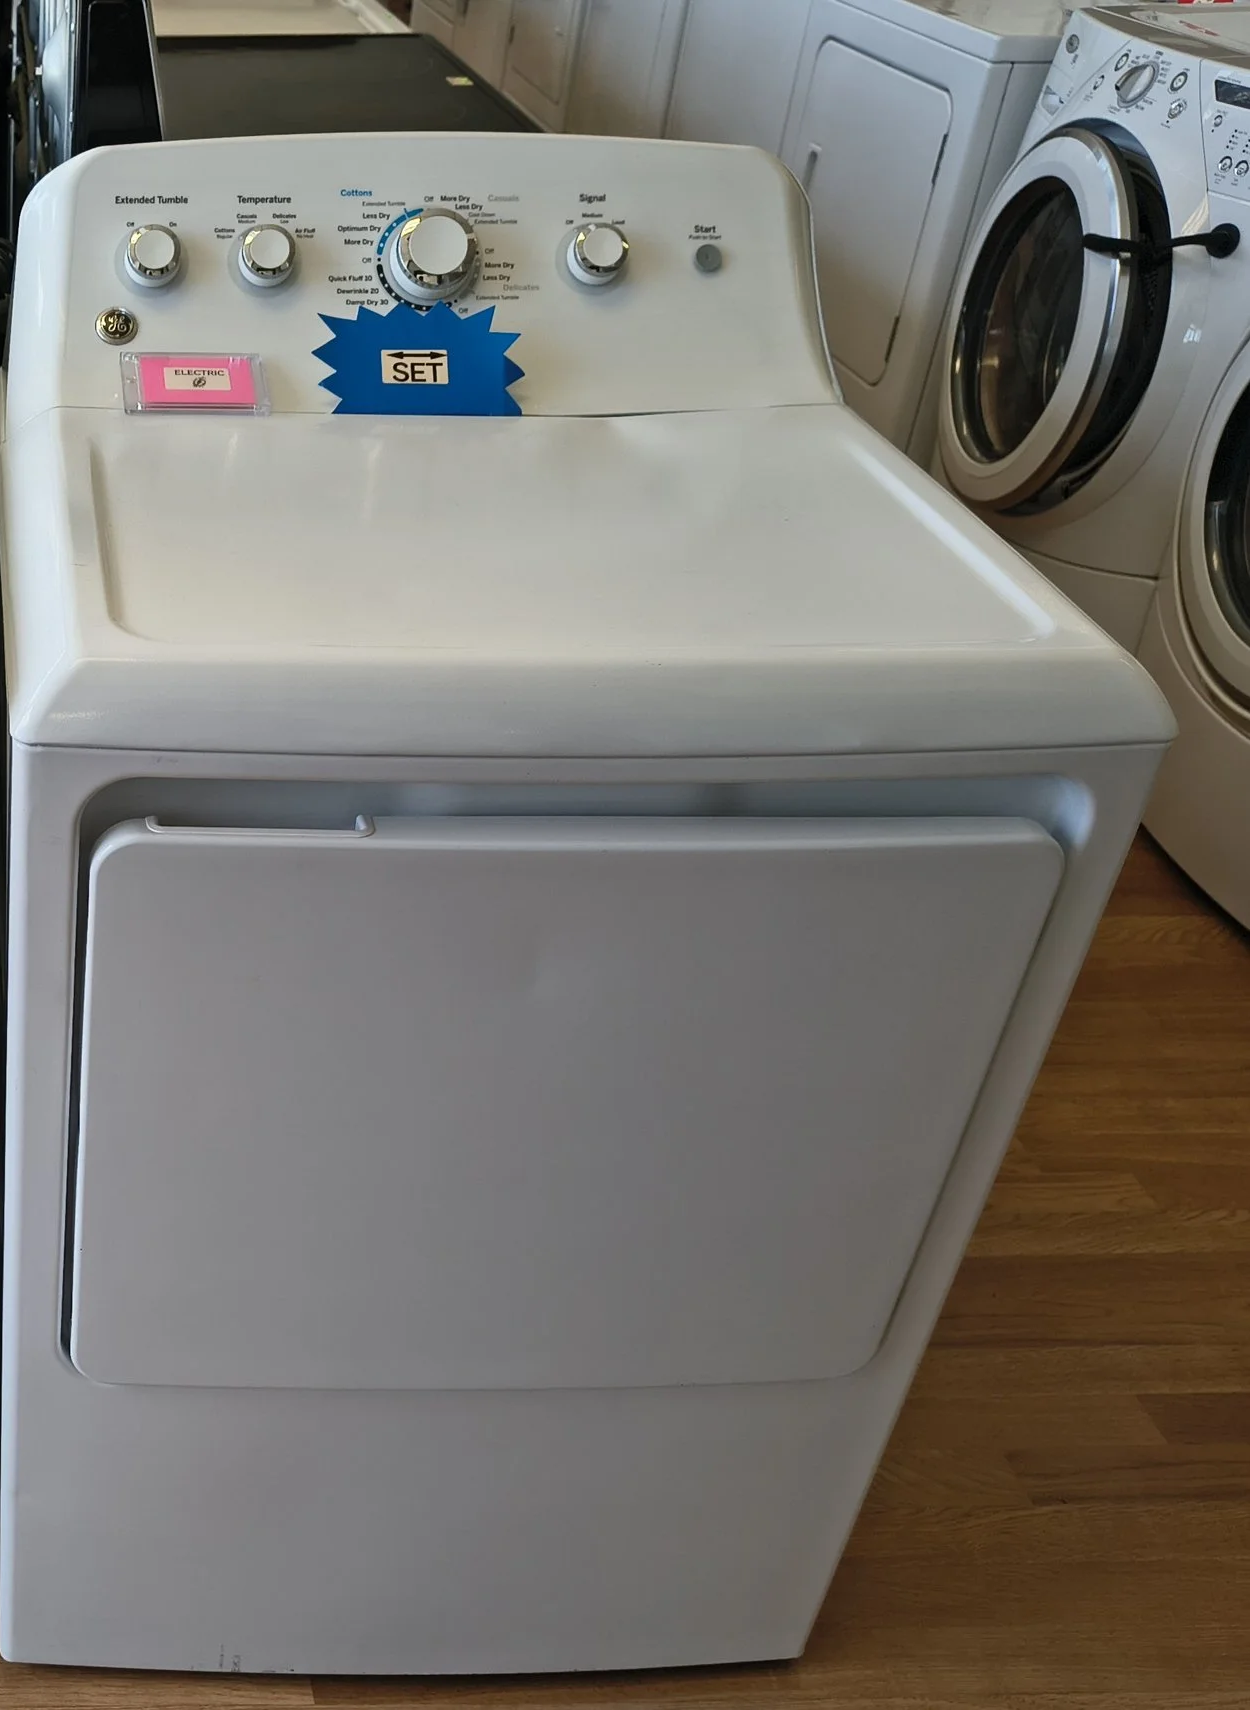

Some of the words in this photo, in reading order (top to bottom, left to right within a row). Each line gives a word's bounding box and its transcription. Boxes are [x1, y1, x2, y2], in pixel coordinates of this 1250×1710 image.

[340, 189, 373, 197] Cottons
[115, 196, 155, 204] Extended
[157, 196, 188, 204] Tumble
[237, 195, 292, 205] Temperature
[457, 195, 470, 203] Dry
[487, 194, 520, 202] Casuals
[579, 193, 606, 204] Signal
[471, 203, 483, 211] Dry
[337, 225, 367, 233] Optimum
[367, 225, 381, 233] Dry
[694, 225, 716, 233] Start
[498, 274, 510, 282] Dry
[174, 369, 225, 377] ELECTRIC
[392, 362, 443, 383] SET
